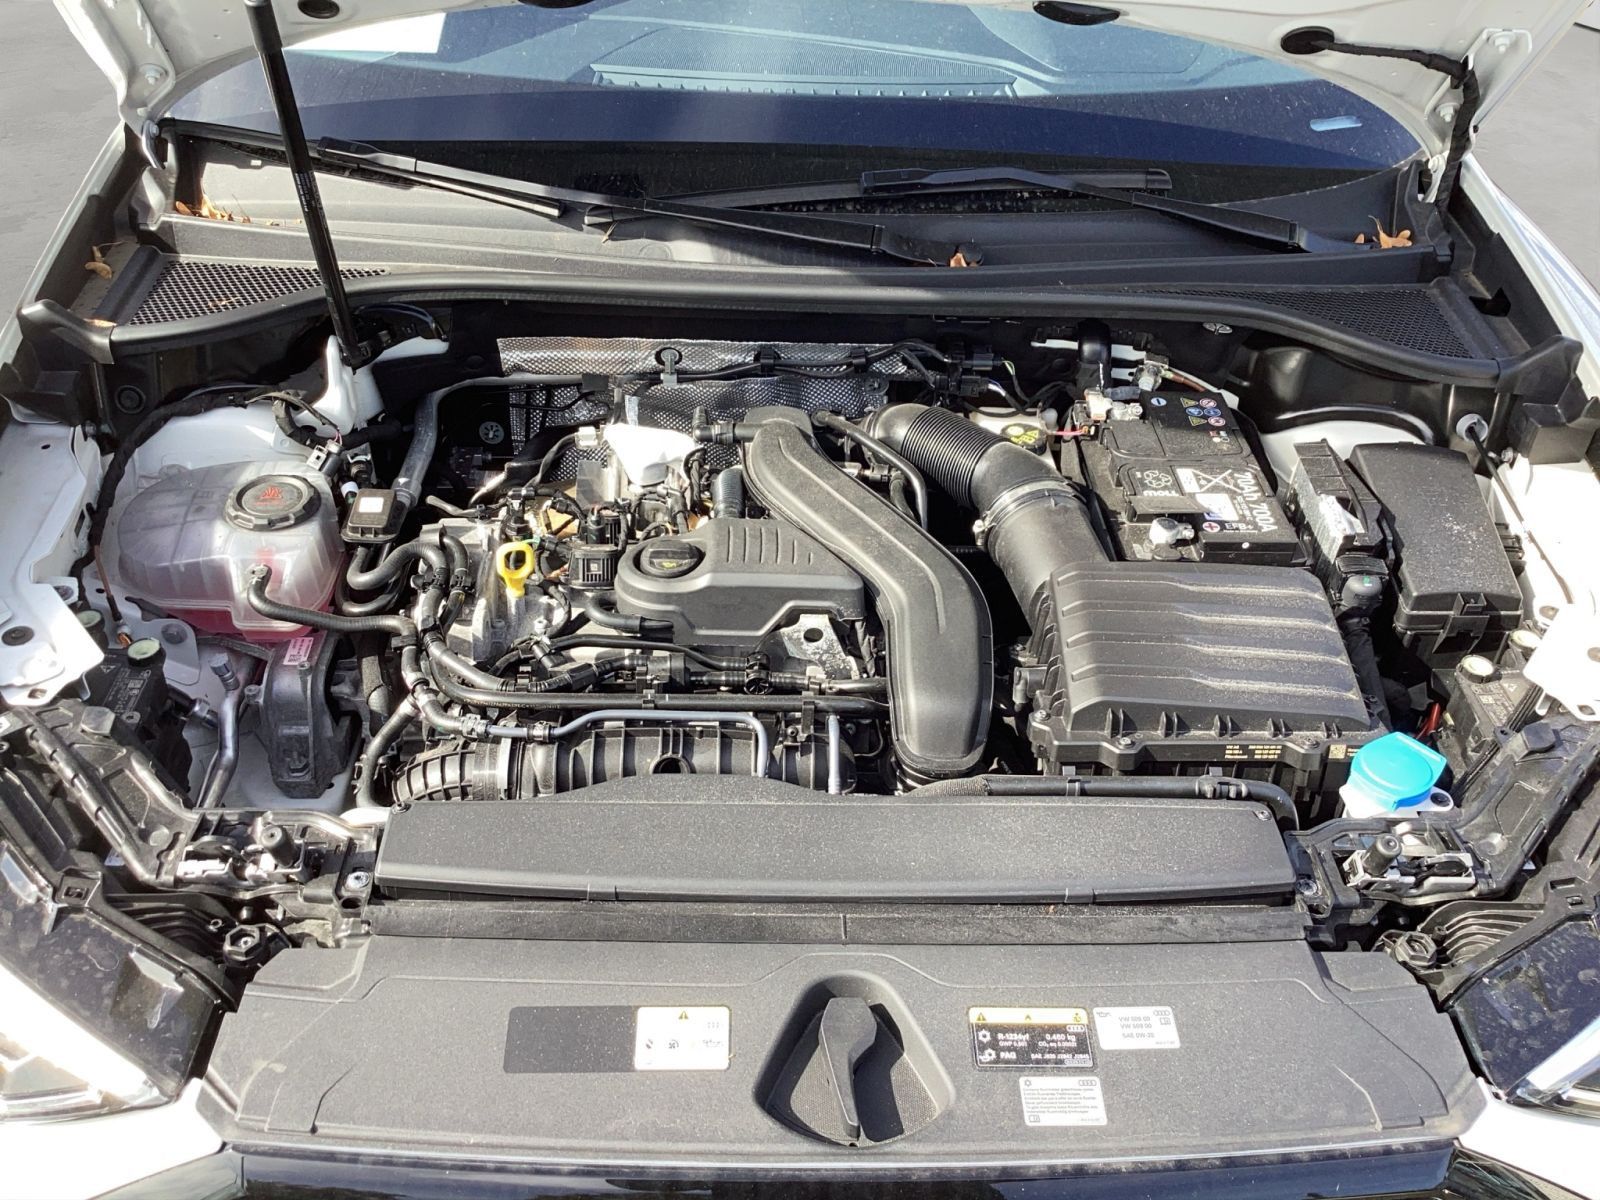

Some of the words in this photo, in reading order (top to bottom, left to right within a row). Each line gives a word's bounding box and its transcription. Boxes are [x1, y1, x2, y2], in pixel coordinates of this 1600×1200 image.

[1234, 472, 1261, 501] 70Ah
[1249, 502, 1278, 532] 700A
[998, 1033, 1029, 1042] R-1234yf
